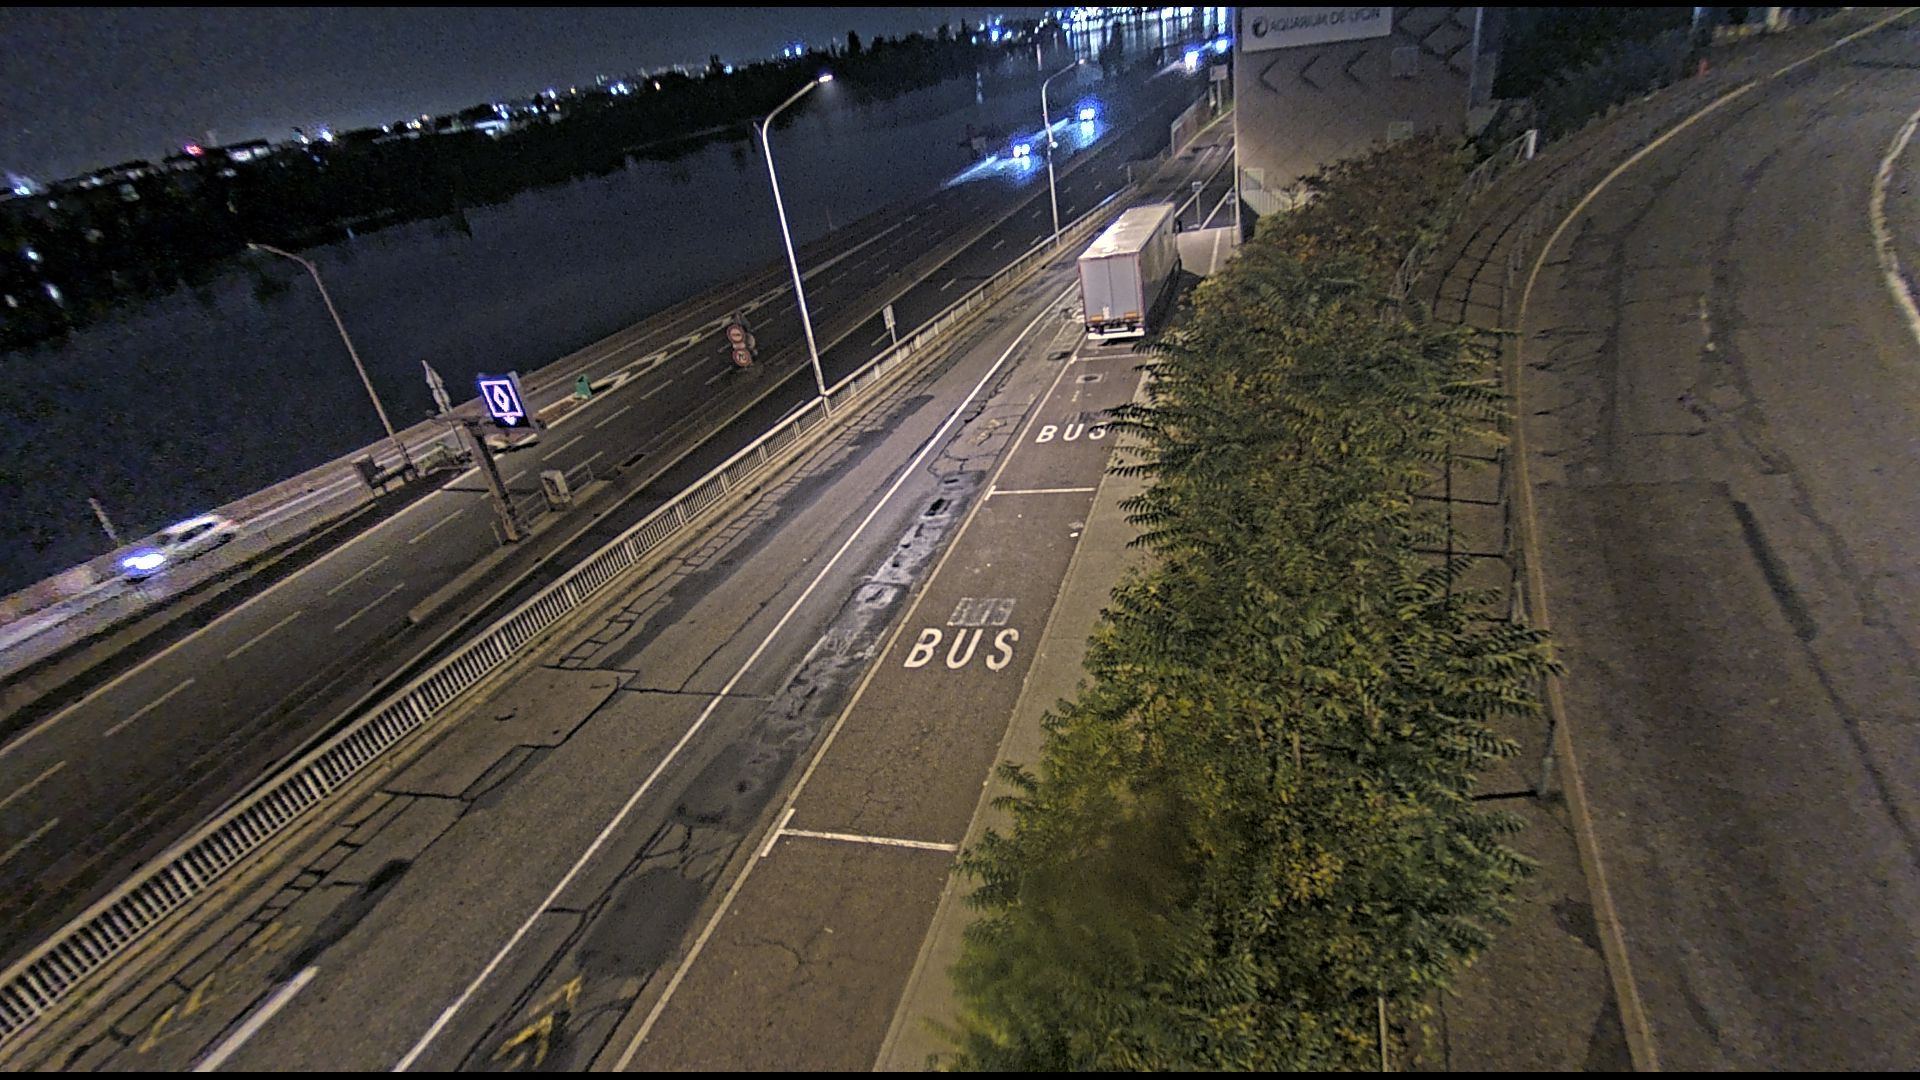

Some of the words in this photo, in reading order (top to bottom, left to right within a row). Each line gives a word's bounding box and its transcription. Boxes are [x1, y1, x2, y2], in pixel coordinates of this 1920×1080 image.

[1270, 14, 1328, 32] AQUARIUM
[1330, 9, 1345, 25] DE
[1036, 422, 1108, 443] BUS
[904, 628, 1019, 671] BUS
